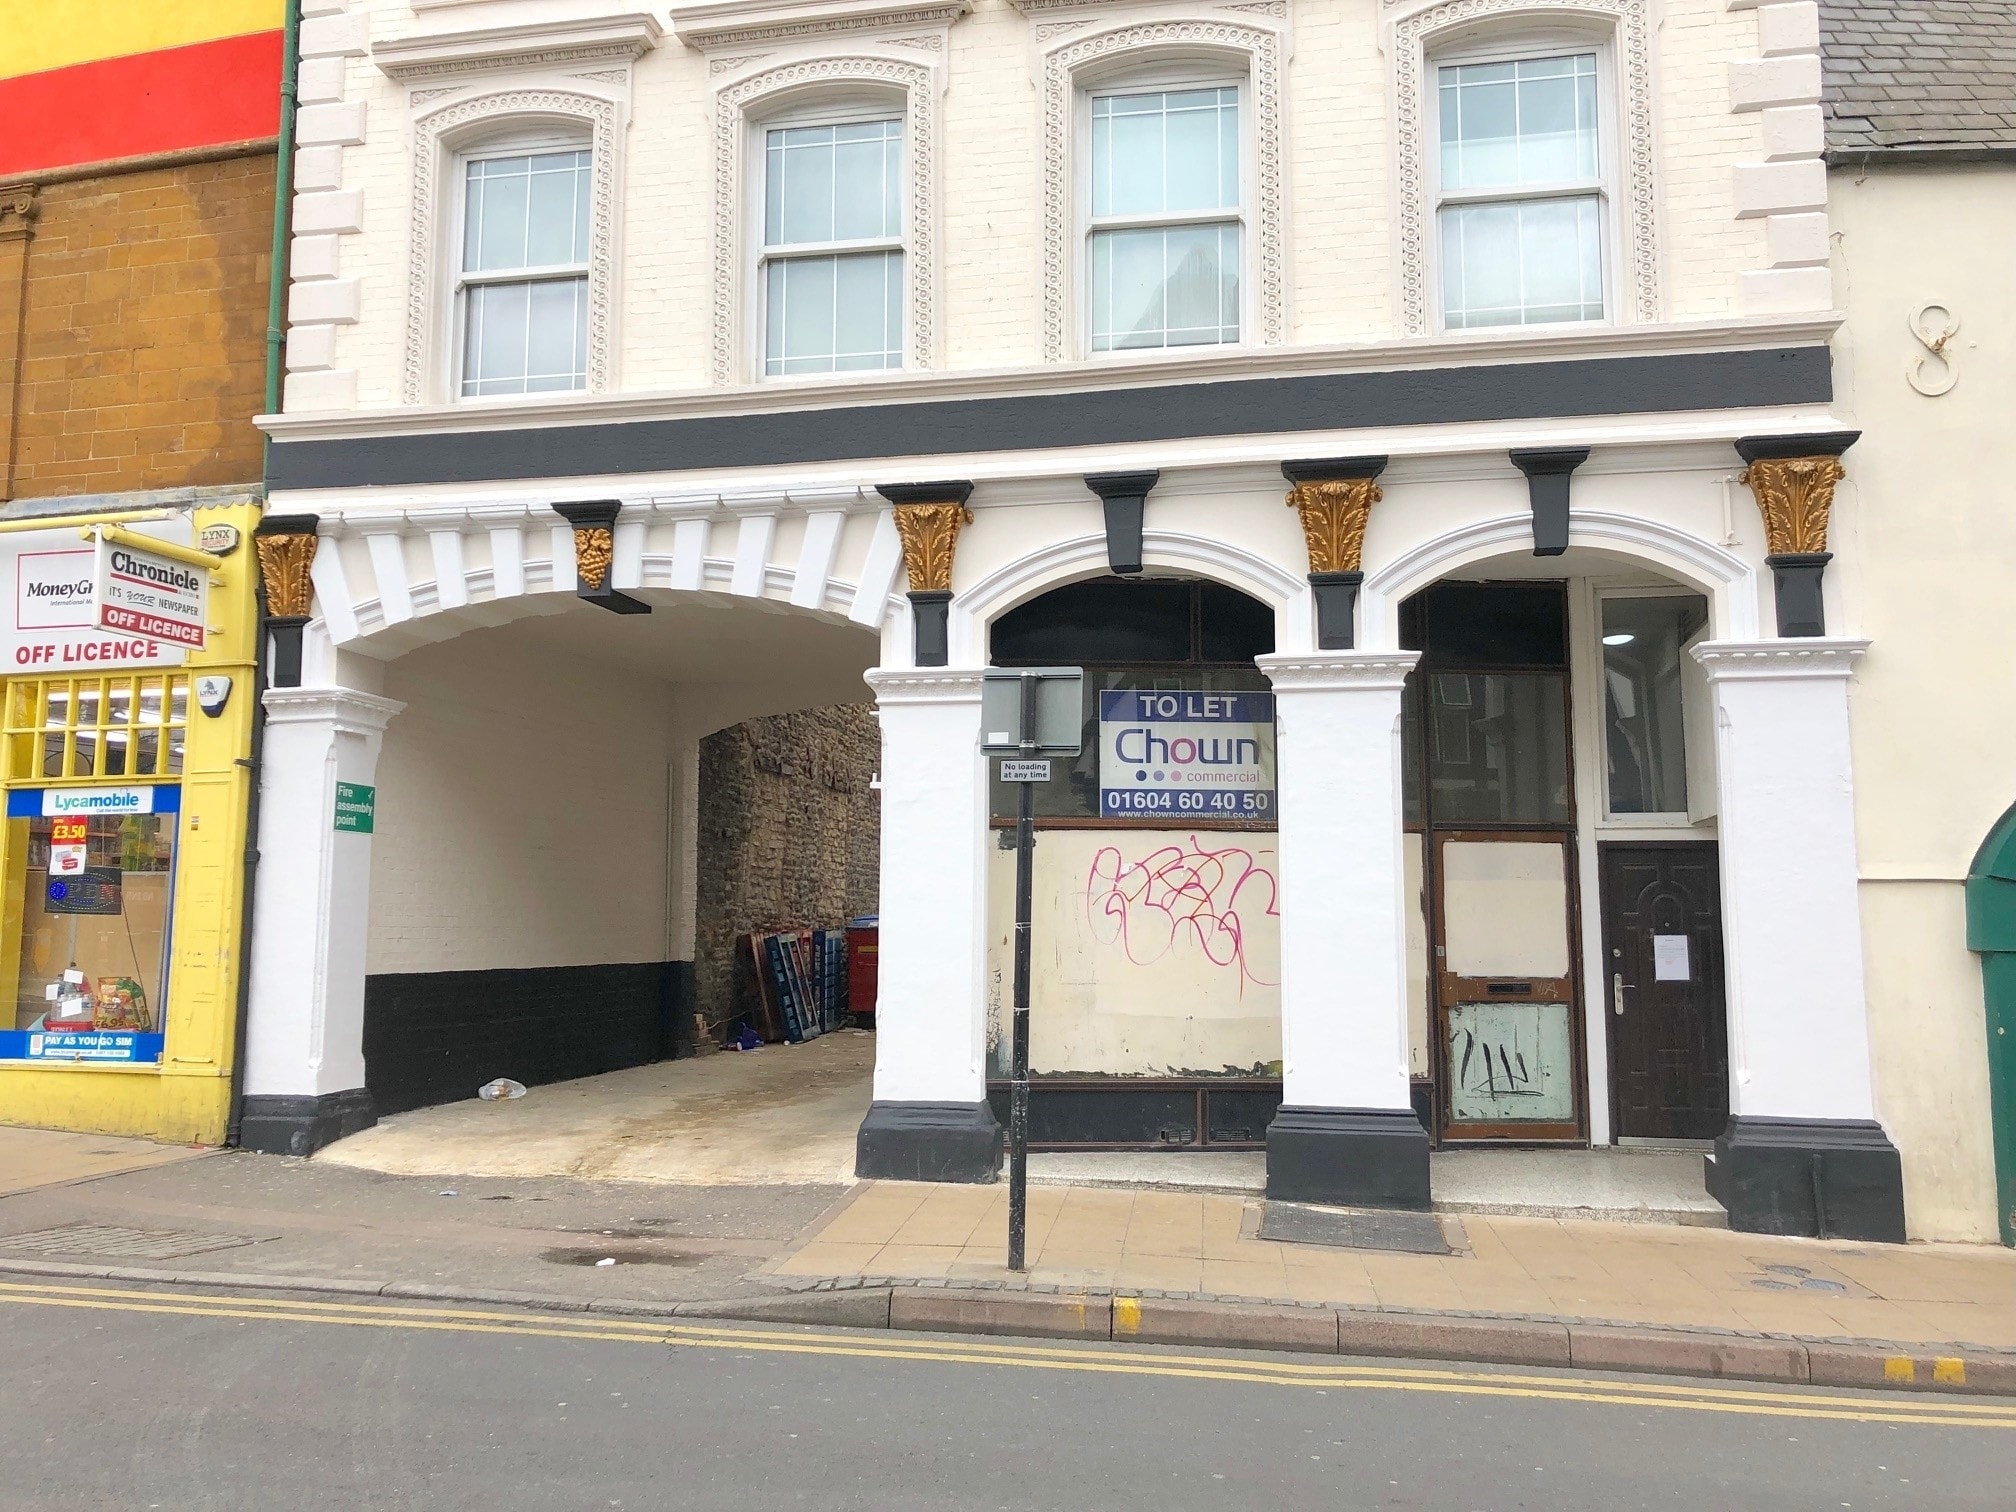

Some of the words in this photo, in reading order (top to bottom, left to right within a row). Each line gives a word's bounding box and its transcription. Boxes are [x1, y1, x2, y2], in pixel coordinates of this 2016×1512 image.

[201, 530, 230, 540] LYNX
[111, 551, 199, 590] Chronicle
[109, 586, 122, 598] IT'S
[126, 591, 155, 604] YOUR
[159, 598, 199, 616] NEWSPAPER
[107, 609, 135, 627] OFF
[139, 617, 201, 642] LICENCE
[16, 645, 55, 664] OFF
[63, 641, 158, 662] LICENCE
[1140, 695, 1178, 717] TO
[1187, 696, 1237, 718] LET
[1115, 728, 1259, 765] Chown
[1018, 763, 1046, 771] loading
[1187, 770, 1260, 782] commercial
[338, 785, 353, 798] Fire
[55, 793, 139, 810] Lycamobile
[1108, 792, 1171, 808] 01604
[1178, 792, 1203, 809] 60
[1210, 793, 1235, 809] 40
[1243, 793, 1268, 810] 50
[336, 802, 373, 816] assembly
[1118, 810, 1258, 819] www.chowncommercial.co.uk
[336, 815, 356, 827] point
[53, 825, 86, 839] £3.50
[45, 1037, 62, 1045] PAY
[63, 1037, 76, 1045] AS
[78, 1037, 98, 1045] YOU
[100, 1038, 113, 1046] GO
[115, 1038, 132, 1046] SIM
